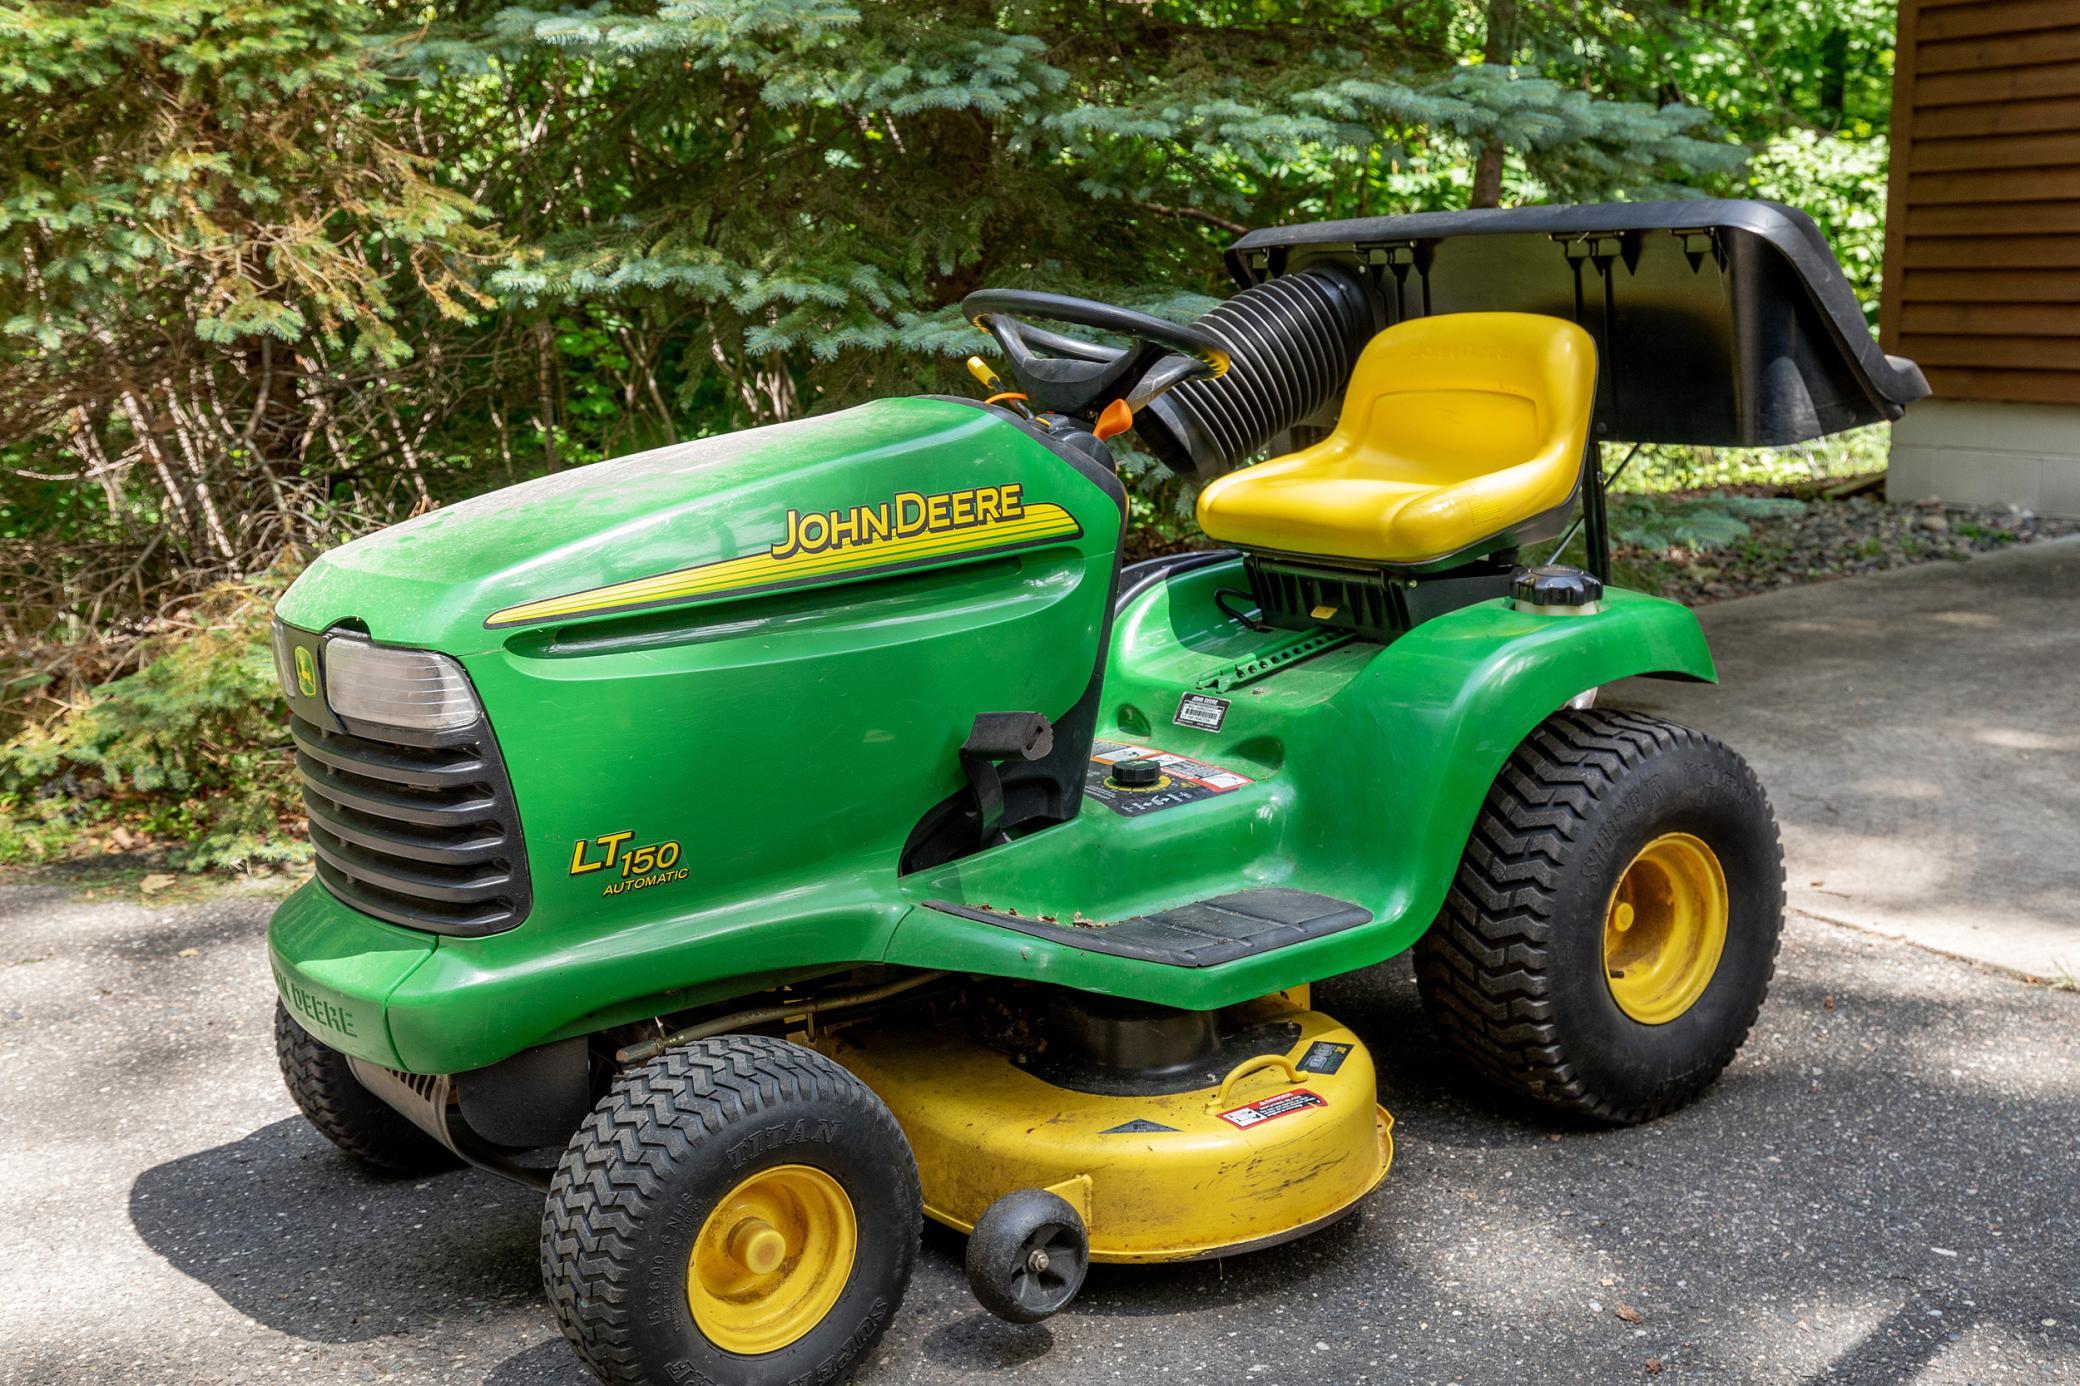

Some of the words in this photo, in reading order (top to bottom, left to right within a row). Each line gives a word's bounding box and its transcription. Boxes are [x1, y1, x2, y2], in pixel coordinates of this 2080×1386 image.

[771, 502, 893, 559] JOHN
[894, 483, 1025, 538] DEERE
[602, 867, 690, 898] AUTOMATIC
[291, 982, 358, 1039] DEERE
[726, 1118, 845, 1170] TITAN
